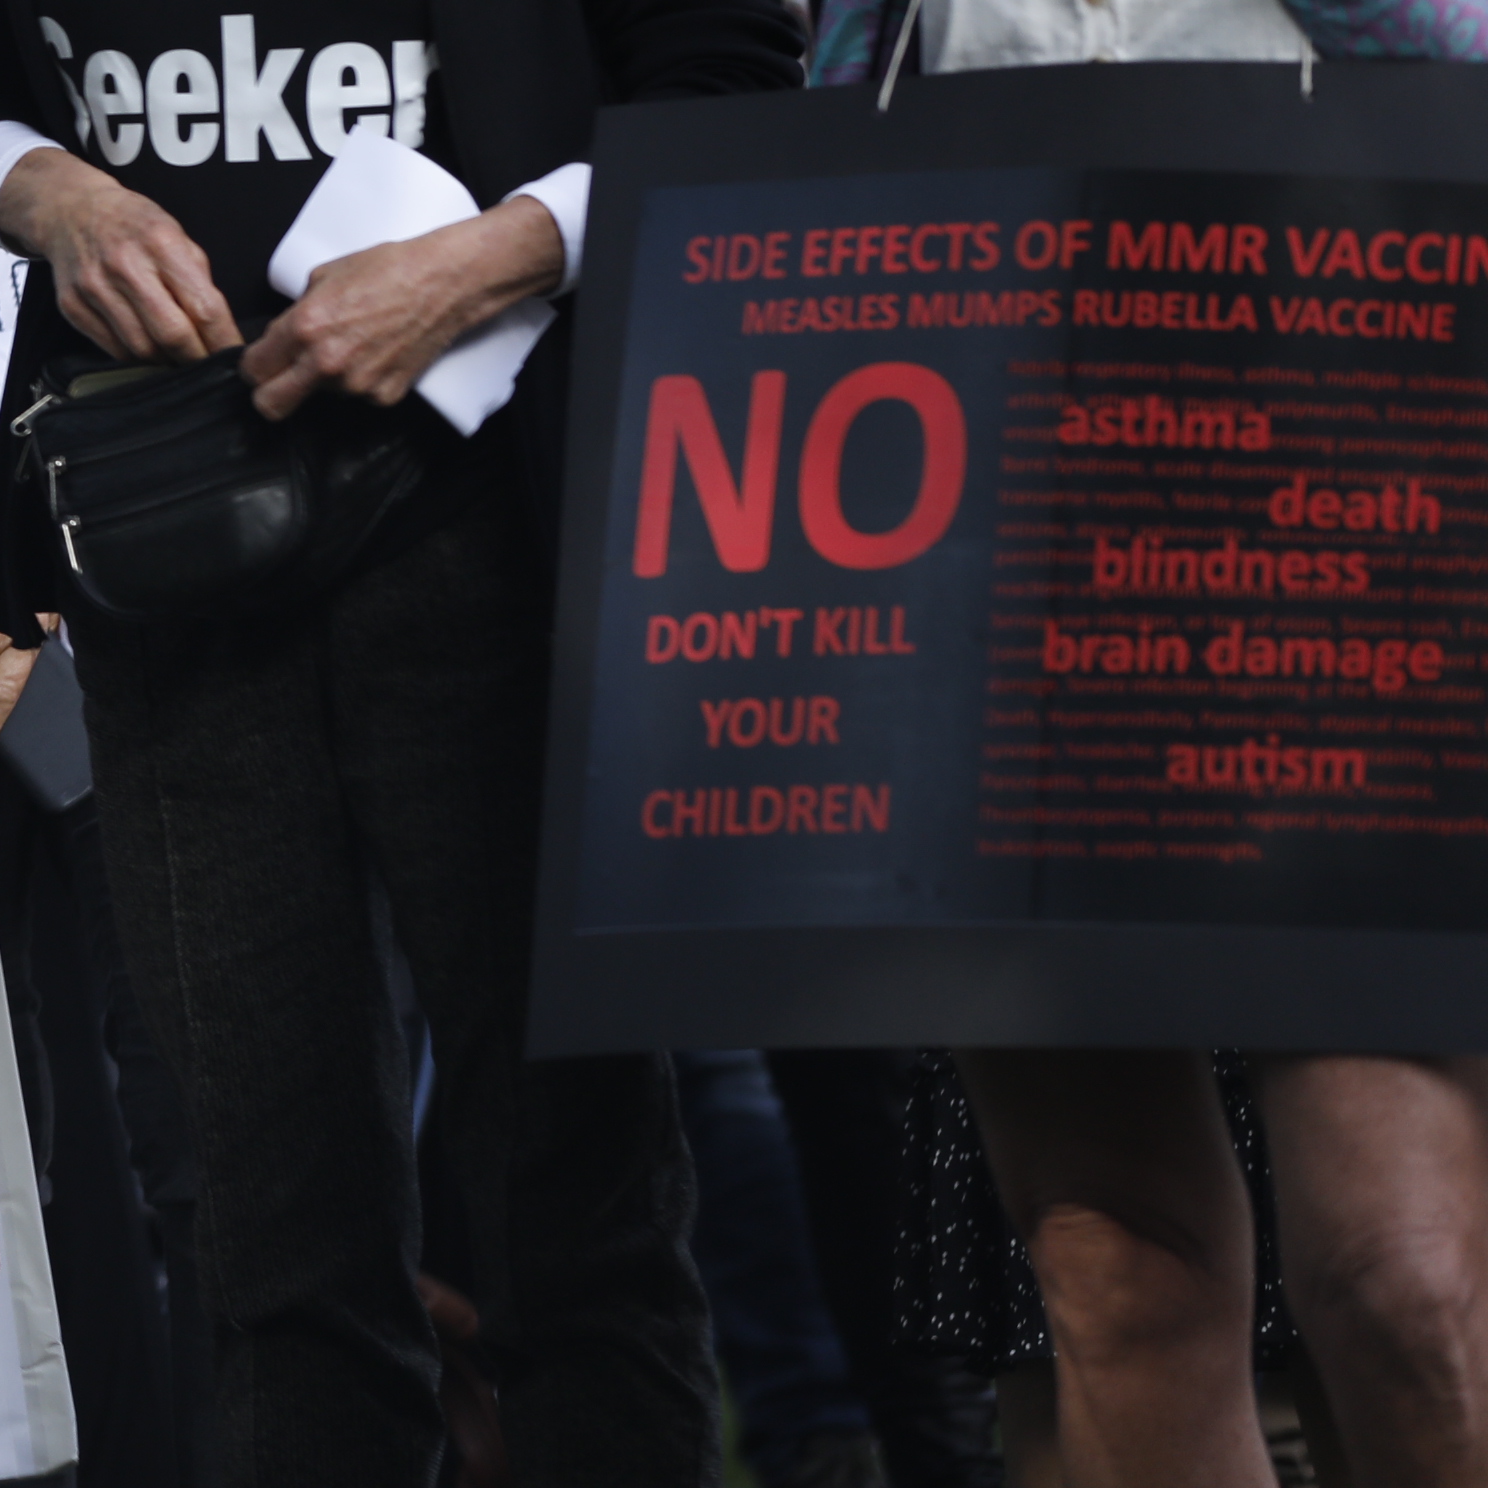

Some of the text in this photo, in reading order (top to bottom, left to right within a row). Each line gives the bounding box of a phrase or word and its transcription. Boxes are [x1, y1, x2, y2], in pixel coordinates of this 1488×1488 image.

[687, 233, 788, 282] SIDE
[803, 223, 999, 276] EFFECTS
[1017, 221, 1091, 269] OF
[1109, 222, 1267, 273] MMR
[741, 289, 1456, 341] MEASLES MUMPS RUBELLA VACCINE
[1057, 396, 1271, 452] asthma
[631, 361, 967, 578] NO
[1268, 474, 1442, 534] death
[1092, 538, 1371, 593] blindness
[647, 608, 916, 663] DON'T KILL
[1043, 620, 1444, 693] brain damage
[703, 698, 838, 746] YOUR
[1166, 734, 1367, 786] autism
[641, 785, 891, 837] CHILDREN
